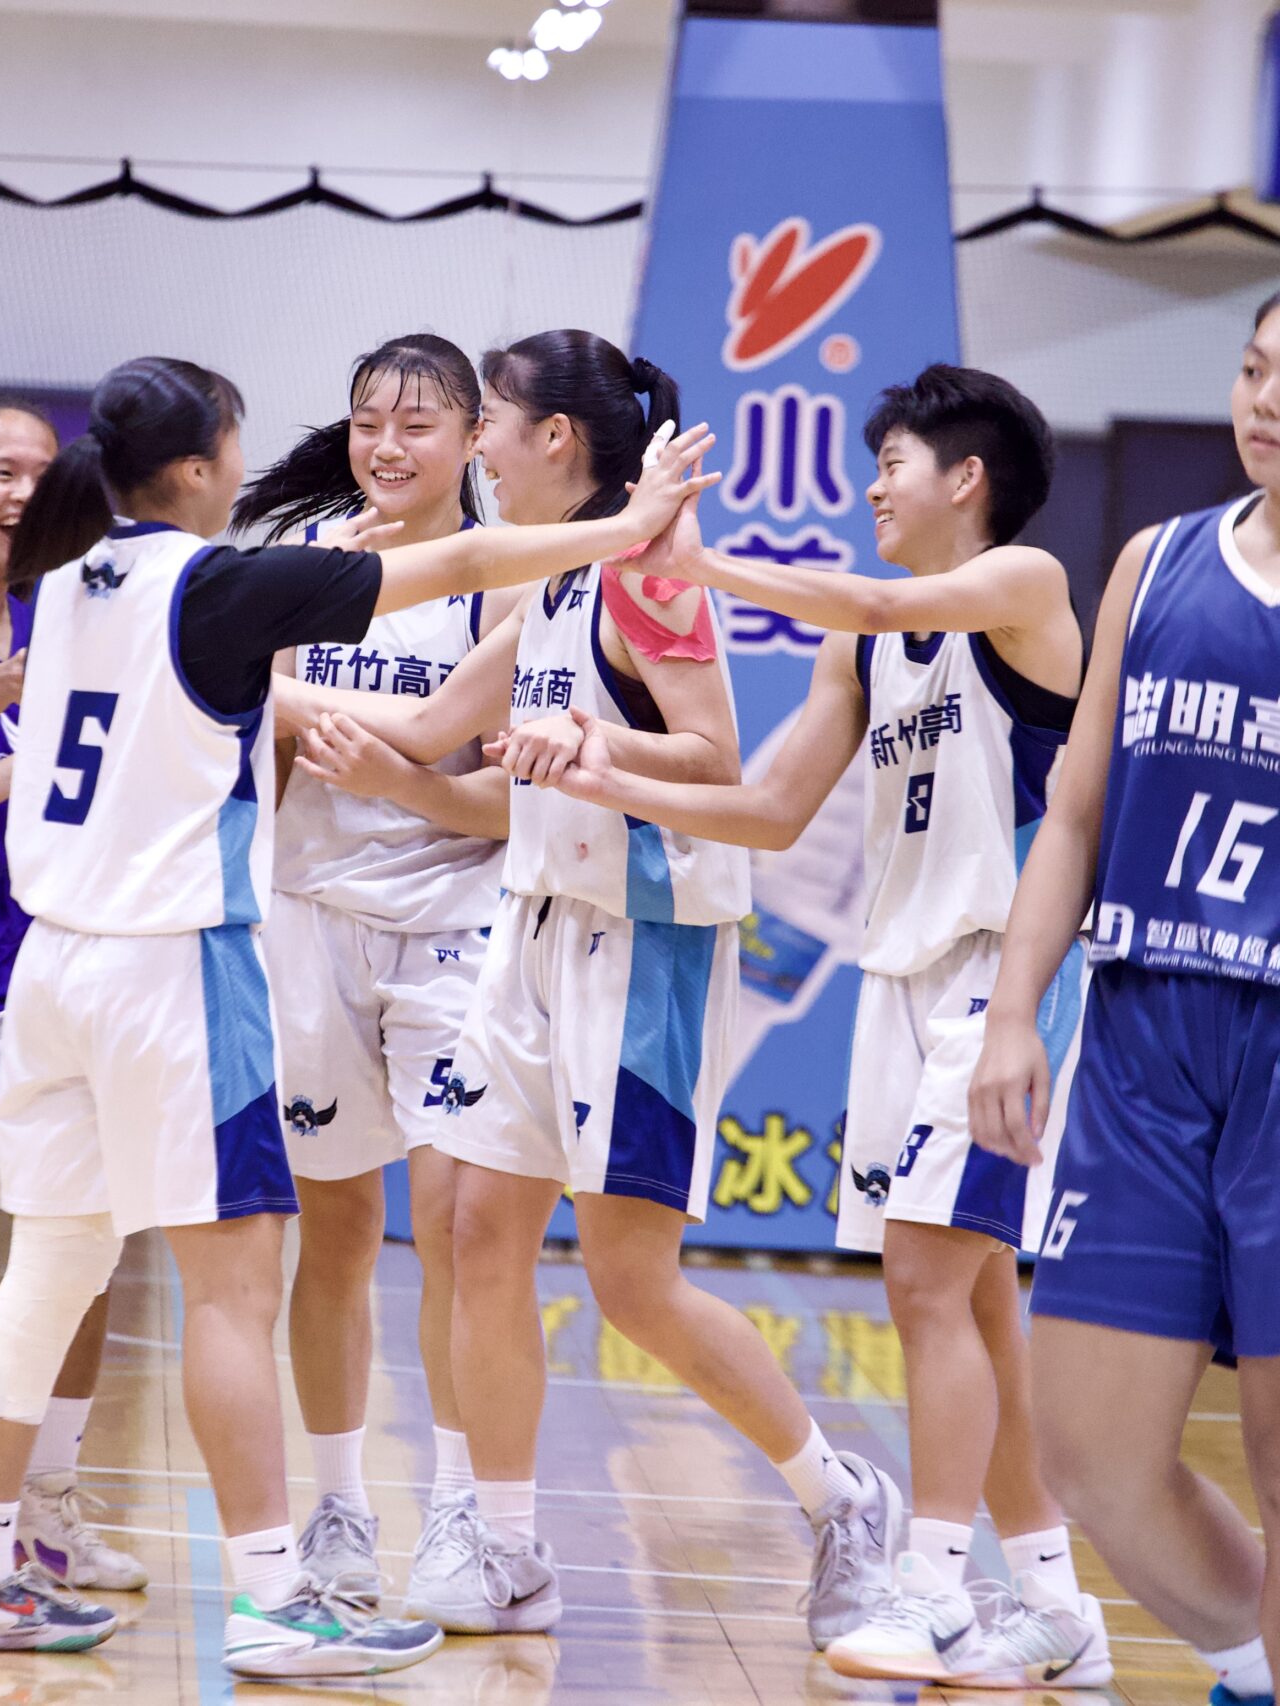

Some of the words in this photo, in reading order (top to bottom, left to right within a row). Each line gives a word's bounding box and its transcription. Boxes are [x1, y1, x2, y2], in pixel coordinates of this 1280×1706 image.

[43, 690, 119, 825] 5
[1133, 740, 1236, 762] CHUNG-MING
[1164, 791, 1280, 904] 16
[713, 1112, 842, 1214] 冰
